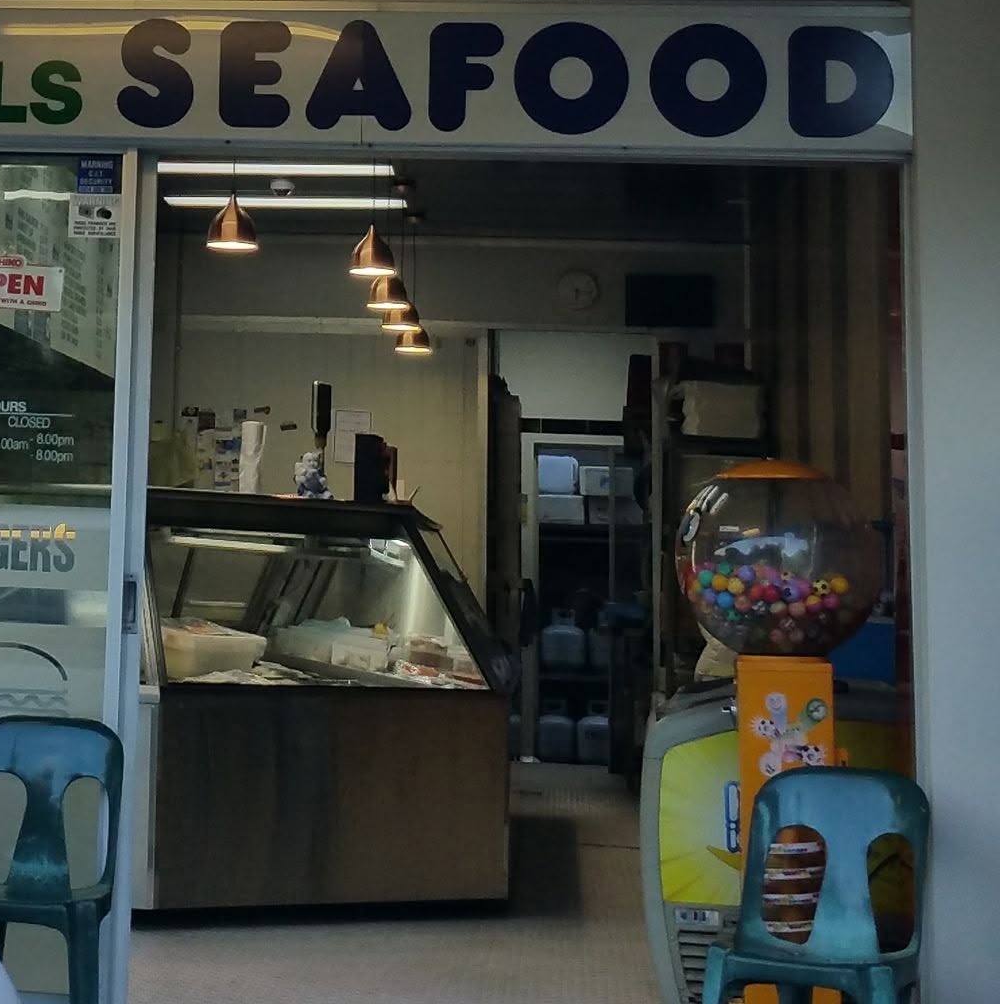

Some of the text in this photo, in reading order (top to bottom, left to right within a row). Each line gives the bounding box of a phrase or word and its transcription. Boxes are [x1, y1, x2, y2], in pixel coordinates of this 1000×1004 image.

[116, 18, 894, 139] SEAFOOD
[7, 416, 51, 429] CLOSED
[36, 433, 76, 448] 8.00pm
